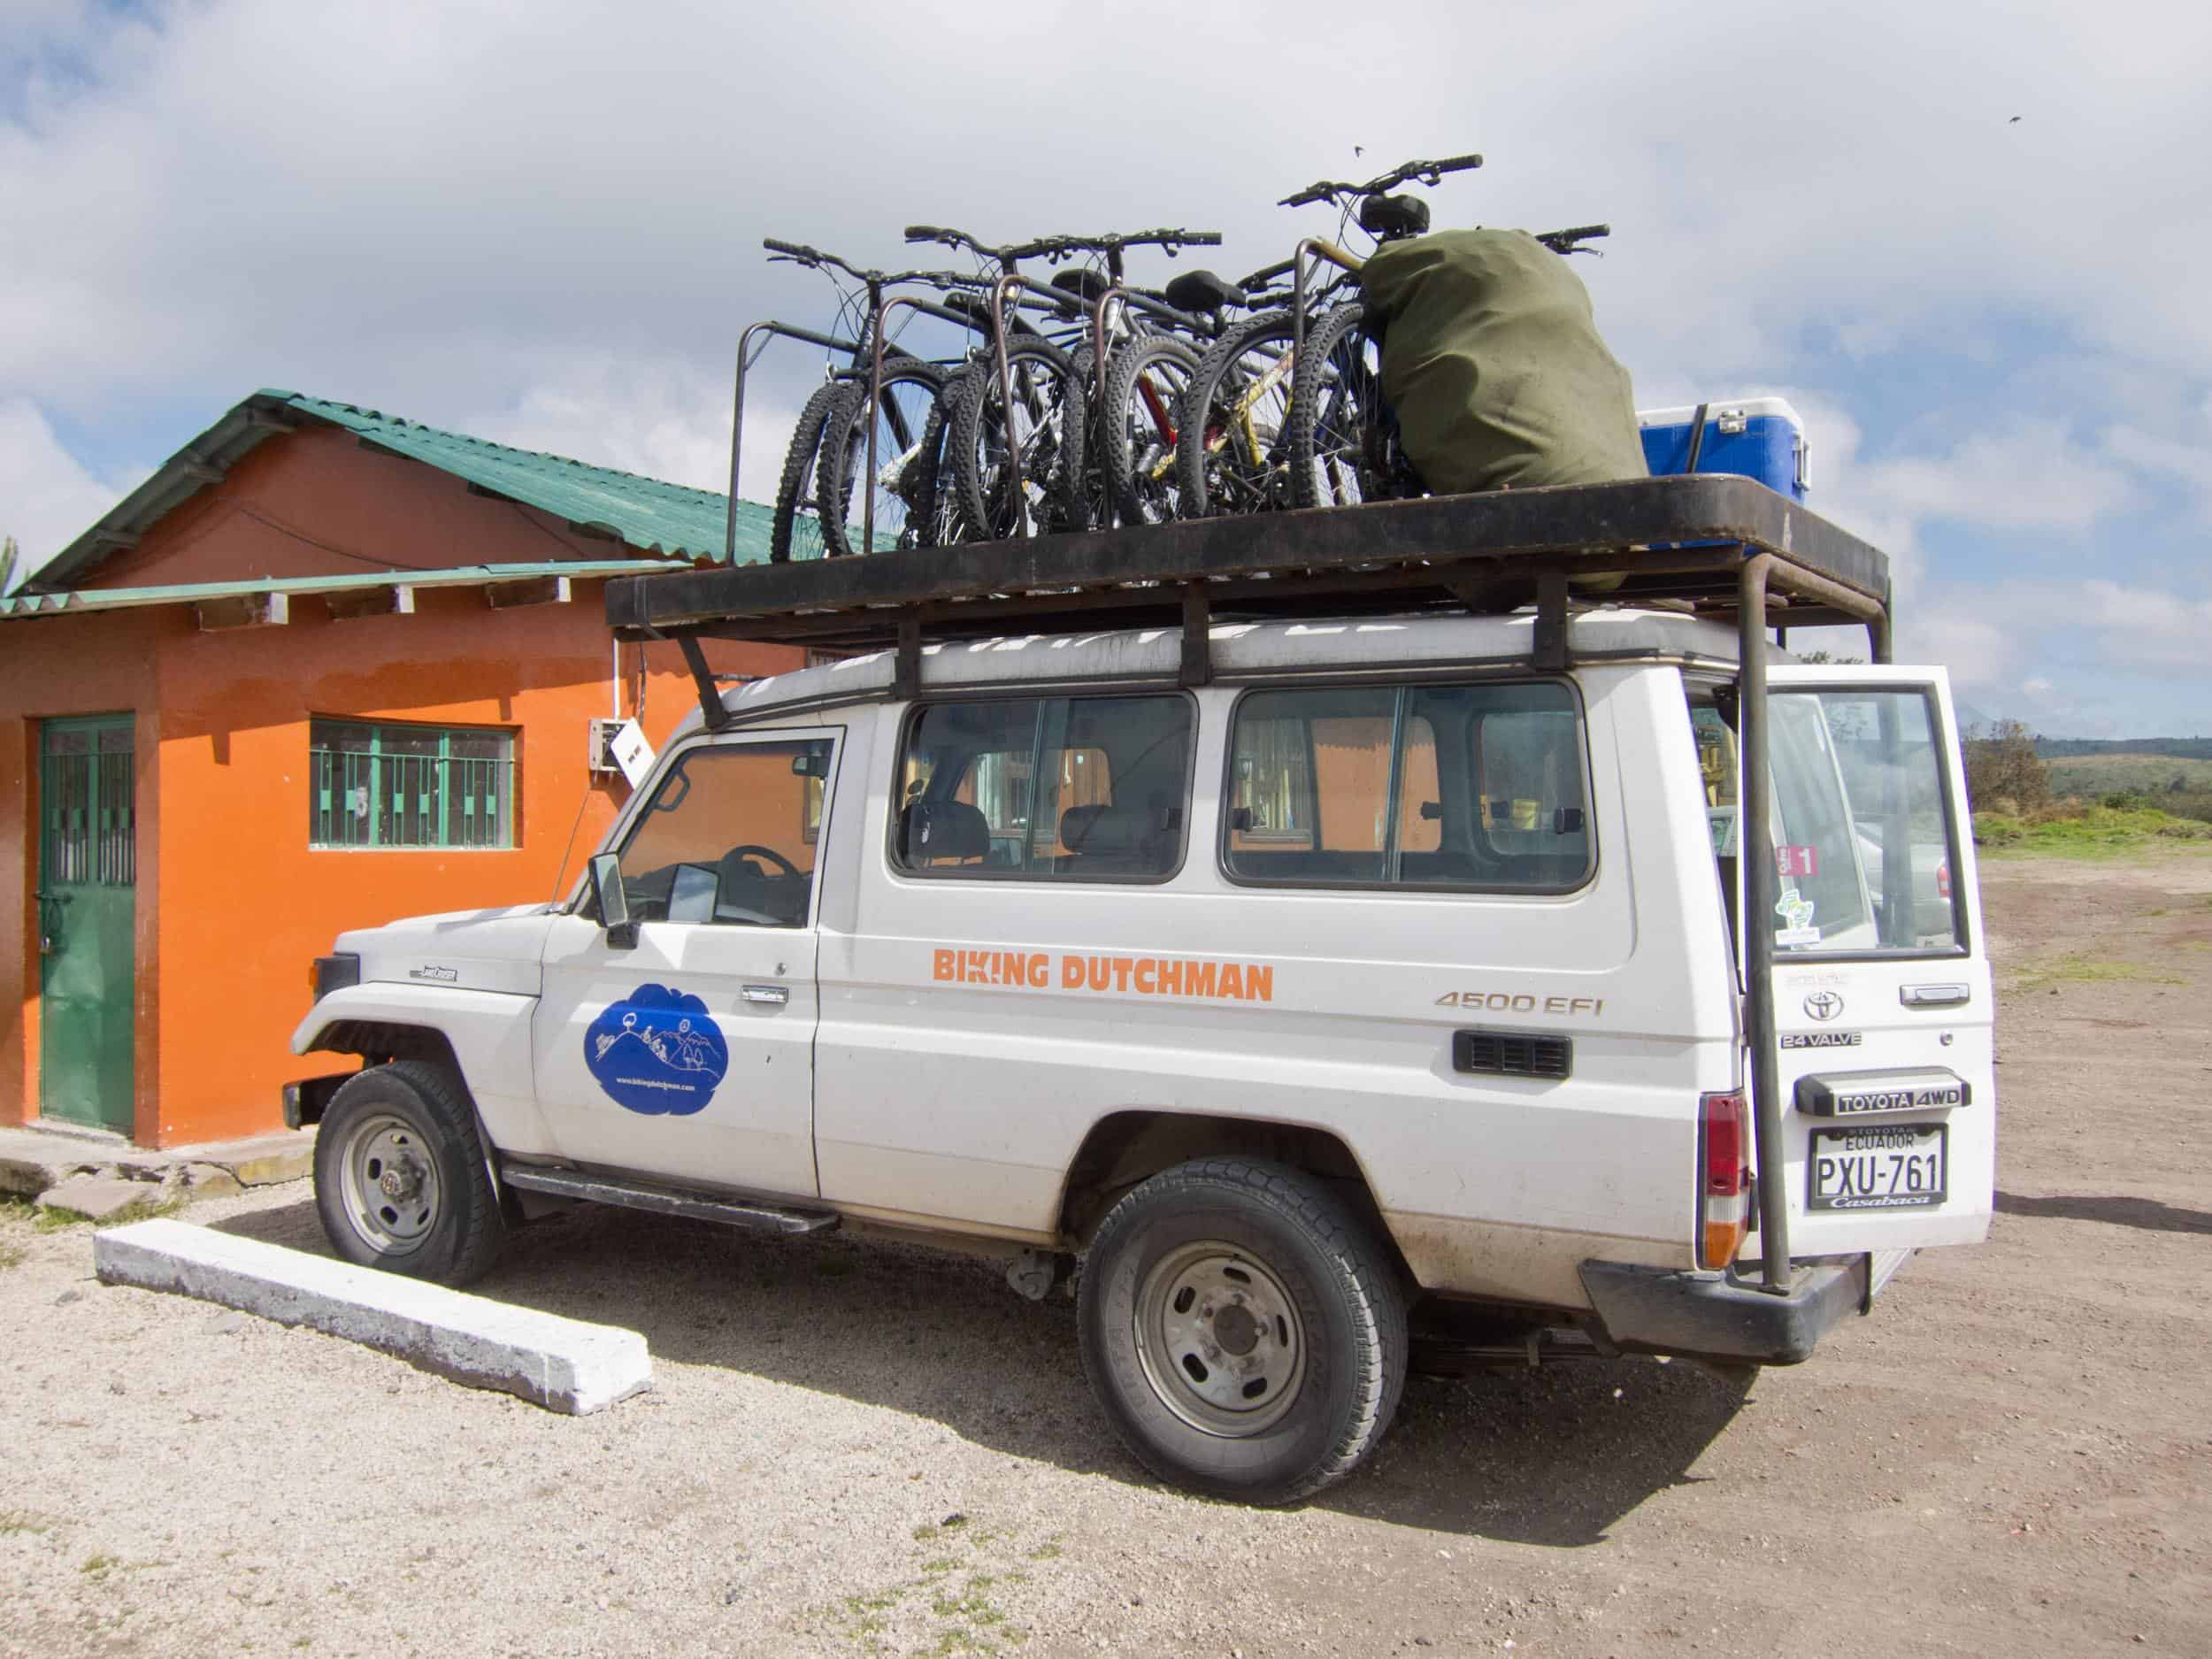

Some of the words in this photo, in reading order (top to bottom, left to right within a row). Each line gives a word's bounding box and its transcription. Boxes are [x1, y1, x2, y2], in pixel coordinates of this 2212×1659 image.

[933, 949, 1049, 987] BIKING
[1061, 955, 1274, 1002] DUTCHMAN
[1434, 991, 1536, 1013] 4500
[1542, 996, 1605, 1017] EFI
[1842, 1094, 1910, 1111] TOYOTA
[1916, 1090, 1959, 1105] 4WD
[1846, 1131, 1915, 1151] ECUADOR
[1818, 1154, 1937, 1196] PXU-761
[1830, 1194, 1932, 1210] Casabaca
